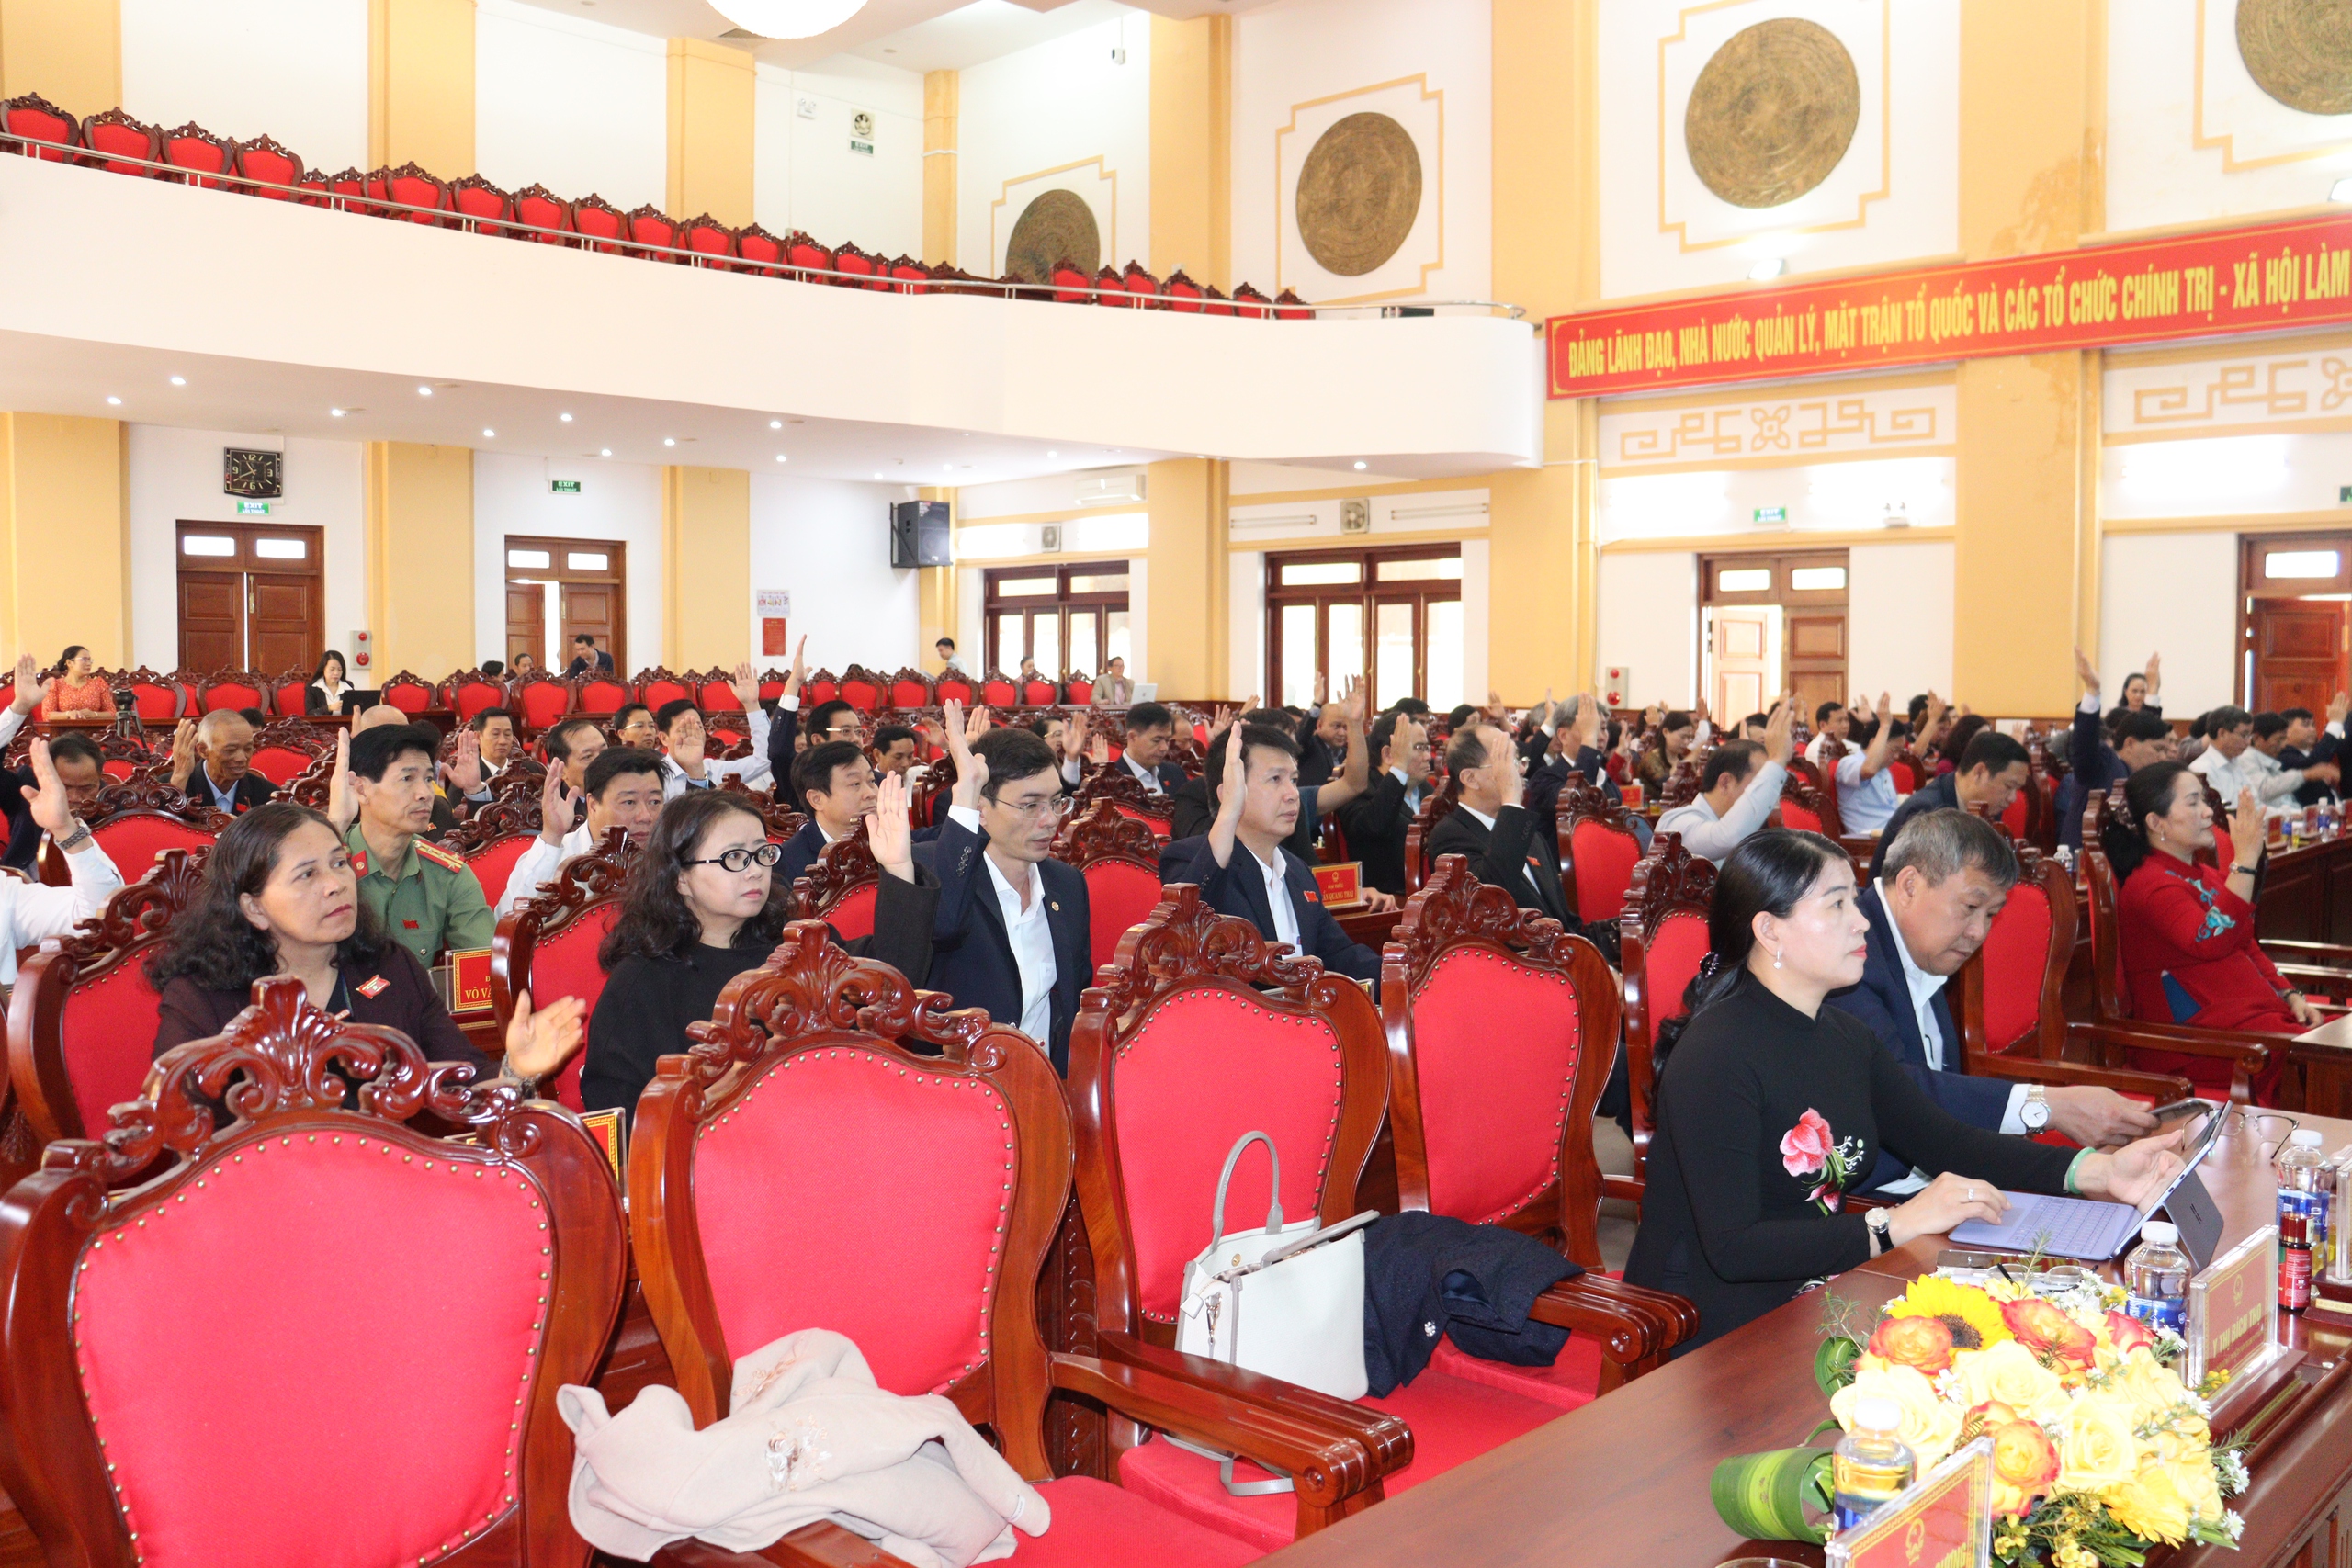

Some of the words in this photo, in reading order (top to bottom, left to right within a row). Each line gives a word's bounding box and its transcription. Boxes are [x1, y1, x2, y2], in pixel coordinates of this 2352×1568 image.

[1568, 328, 1604, 378] ĐẢNG
[1607, 324, 1643, 373] LÃNH
[1645, 329, 1676, 378] ĐẠO,
[1679, 319, 1709, 366] NHÀ
[1712, 313, 1751, 362] NƯỚC
[1754, 304, 1794, 361] QUẢN
[1799, 303, 1820, 356] LÝ,
[1824, 299, 1857, 357] MẶT
[1860, 295, 1902, 354] TRẬN
[1905, 283, 1927, 341] TỔ
[1930, 279, 1973, 344] QUỐC
[1977, 281, 2000, 334] VÀ
[2004, 279, 2039, 332] CÁC
[2042, 265, 2065, 328] TỔ
[2069, 269, 2118, 325] CHỨC
[2121, 263, 2179, 321] CHÍNH
[2184, 265, 2215, 321] TRỊ
[2233, 252, 2260, 309] XÃ
[2265, 246, 2299, 313] HỘI
[2305, 242, 2351, 301] LÀM
[232, 466, 239, 474] 9
[266, 468, 274, 478] 3
[249, 481, 256, 491] 6
[465, 986, 480, 999] VÕ
[2212, 1337, 2218, 1359] Y
